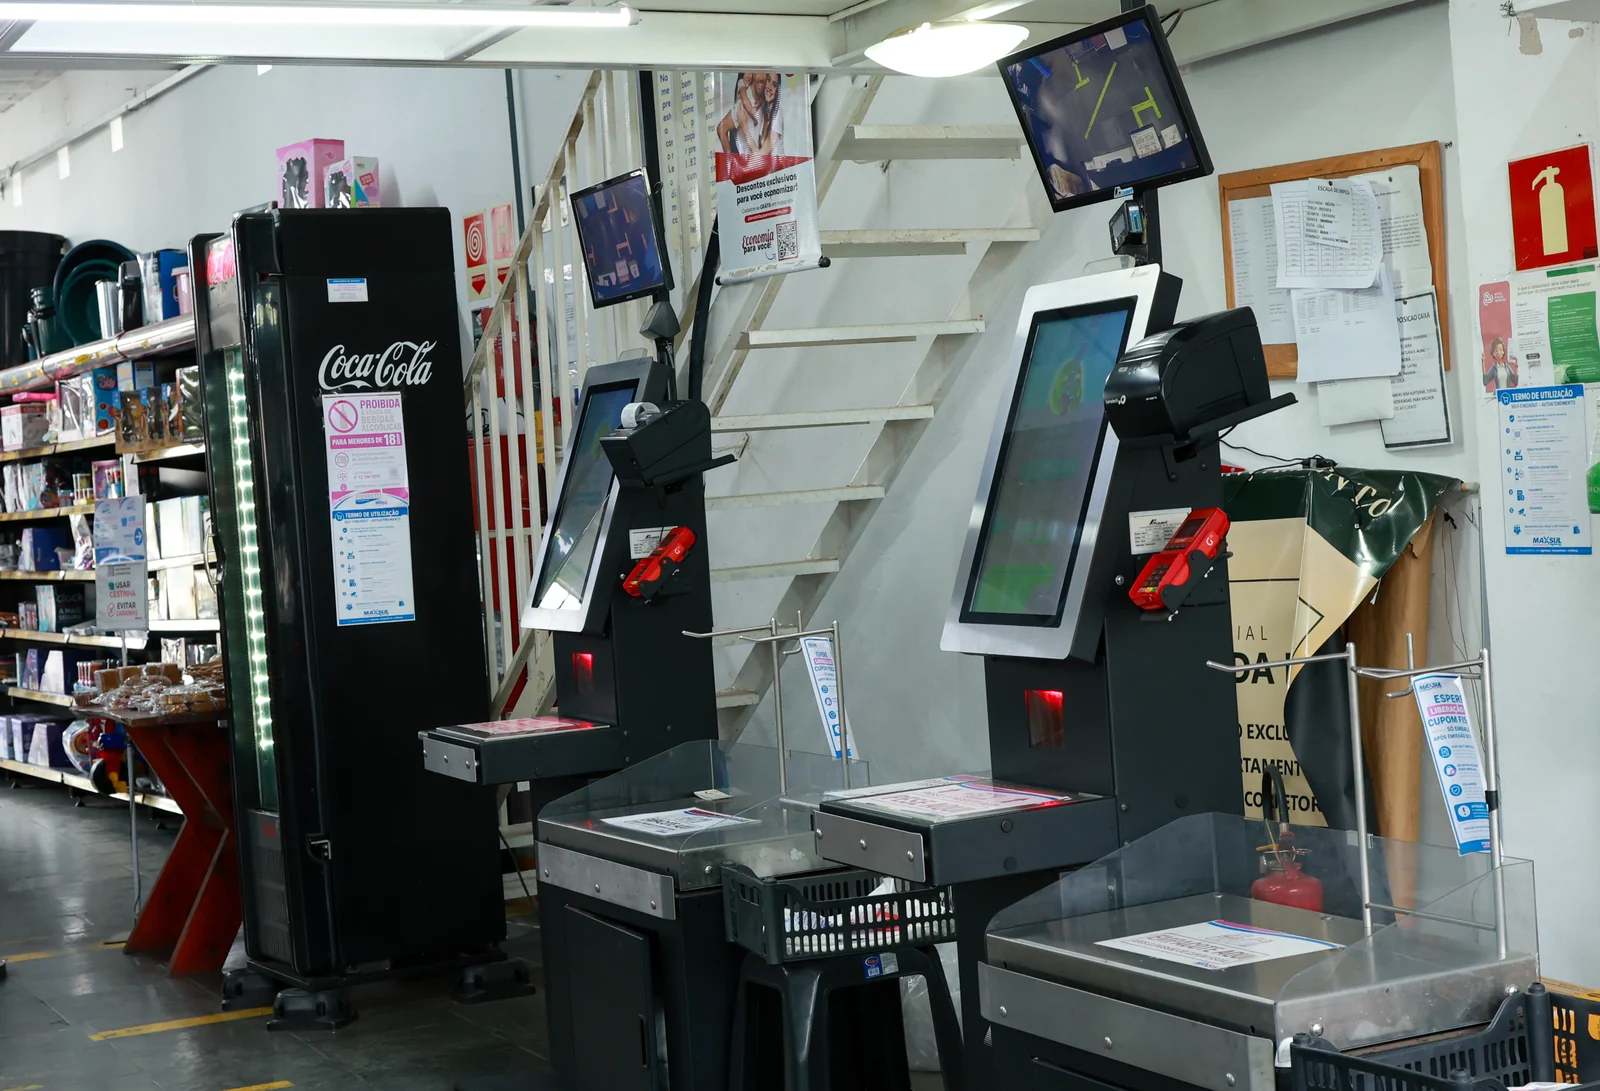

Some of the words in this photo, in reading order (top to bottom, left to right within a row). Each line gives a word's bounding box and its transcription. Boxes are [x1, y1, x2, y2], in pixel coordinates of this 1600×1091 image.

[736, 181, 766, 194] Descontos
[767, 173, 797, 186] exclusivos
[737, 195, 750, 206] para
[750, 190, 764, 200] você
[764, 183, 798, 198] economizar!
[495, 210, 508, 252] H
[742, 229, 774, 248] Economia
[744, 244, 756, 255] para
[757, 242, 772, 250] você!
[318, 340, 438, 390] Coca-Cola
[1540, 388, 1573, 399] UTILIZAÇÃO
[360, 399, 400, 409] PROIBIDA
[362, 415, 394, 424] BEBIDAS
[362, 422, 402, 432] ALCOÓLICAS
[348, 436, 375, 445] MENORES
[384, 434, 396, 445] 18
[370, 510, 399, 518] UTILIZAÇÃO
[1428, 716, 1458, 727] CUPOM
